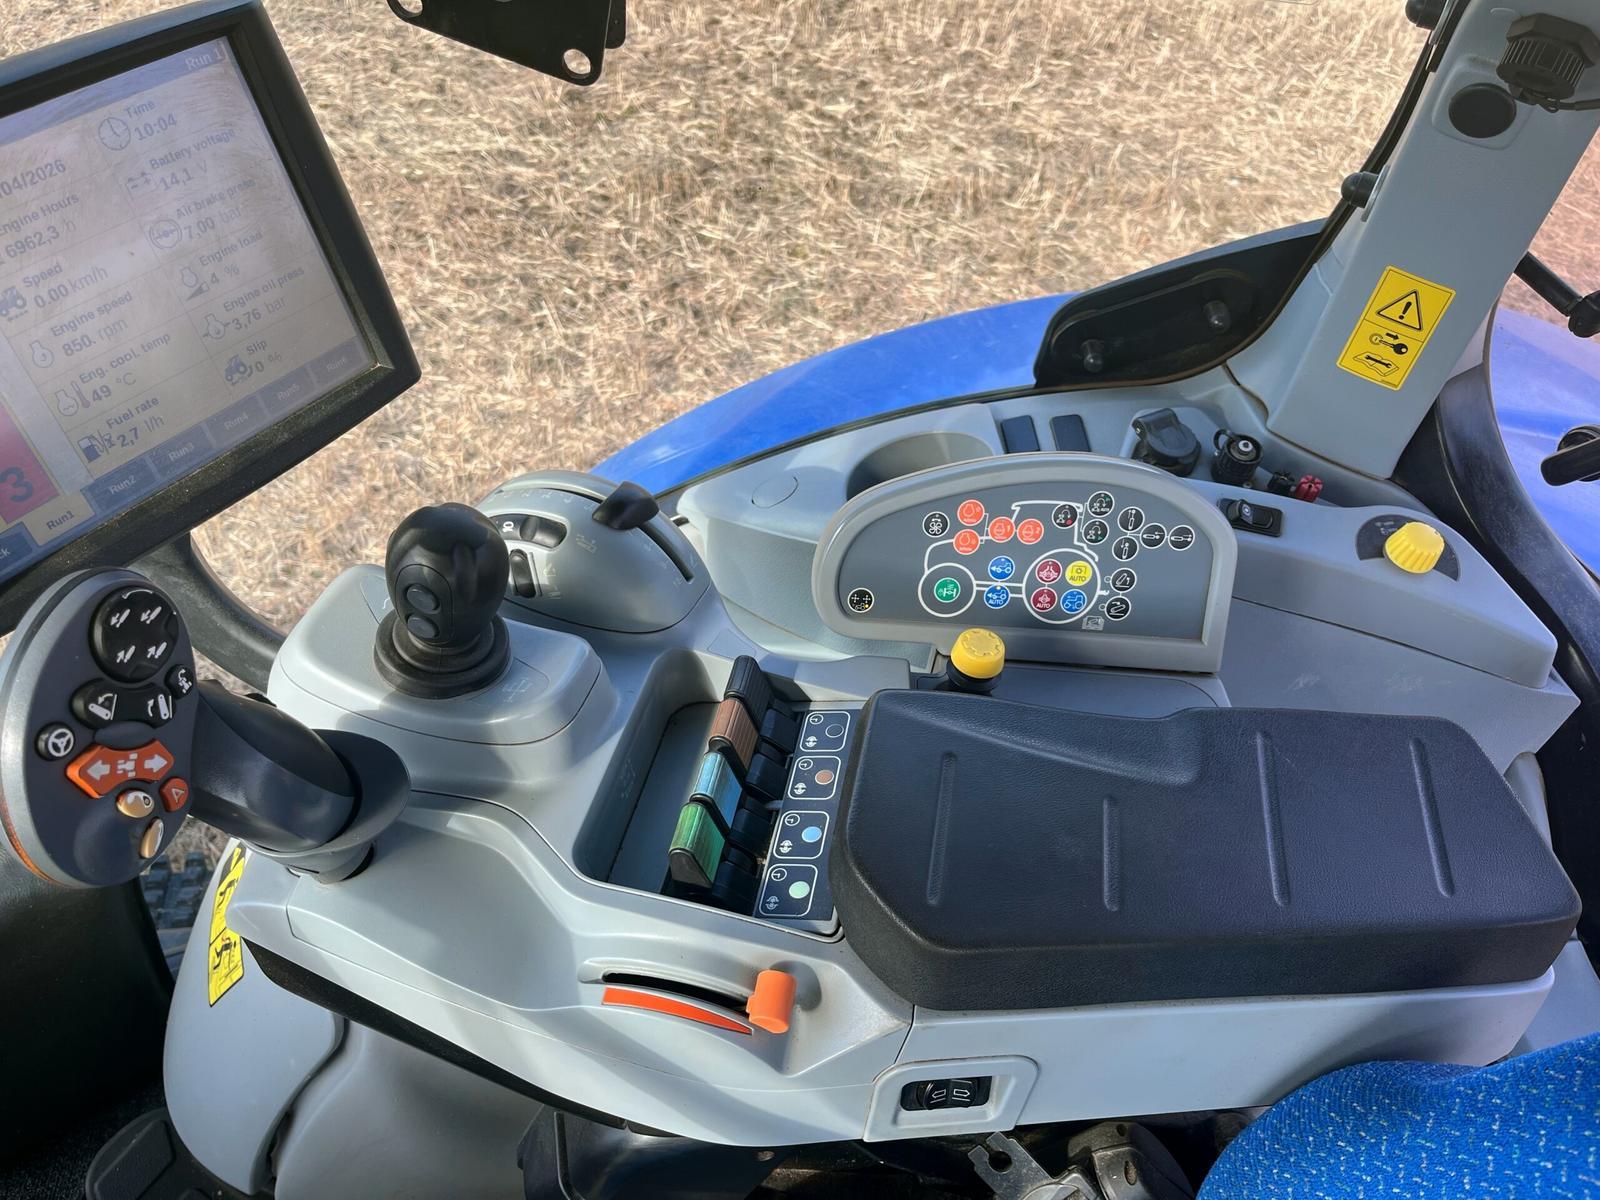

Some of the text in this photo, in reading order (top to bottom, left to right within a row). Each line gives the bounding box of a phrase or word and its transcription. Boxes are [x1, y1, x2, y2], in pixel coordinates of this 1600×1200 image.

[185, 54, 213, 71] Run
[124, 101, 156, 119] Time
[135, 113, 178, 140] 10:04
[149, 129, 236, 170] Battery voltage
[160, 168, 194, 191] 14,1
[40, 193, 79, 217] Hours
[176, 207, 192, 219] Air
[219, 206, 242, 225] bar
[5, 225, 60, 259] 6962,3
[199, 231, 263, 266] Engine load
[22, 263, 63, 288] Speed
[34, 266, 109, 308] 0.00 km/h
[211, 272, 220, 285] 4
[223, 267, 305, 313] Engine oil press
[51, 291, 133, 337] Engine speed
[264, 297, 286, 315] bar
[98, 319, 129, 342] rpm
[246, 339, 268, 354] Slip
[79, 334, 171, 385] Eng. cool. temp
[92, 385, 112, 402] 49
[105, 396, 160, 430] Fuel rate
[117, 427, 140, 449] 2,7
[168, 442, 195, 462] Run3
[0, 466, 33, 503] 3
[109, 475, 137, 495] Run2
[46, 510, 75, 530] Run1
[987, 598, 1004, 606] AUTO
